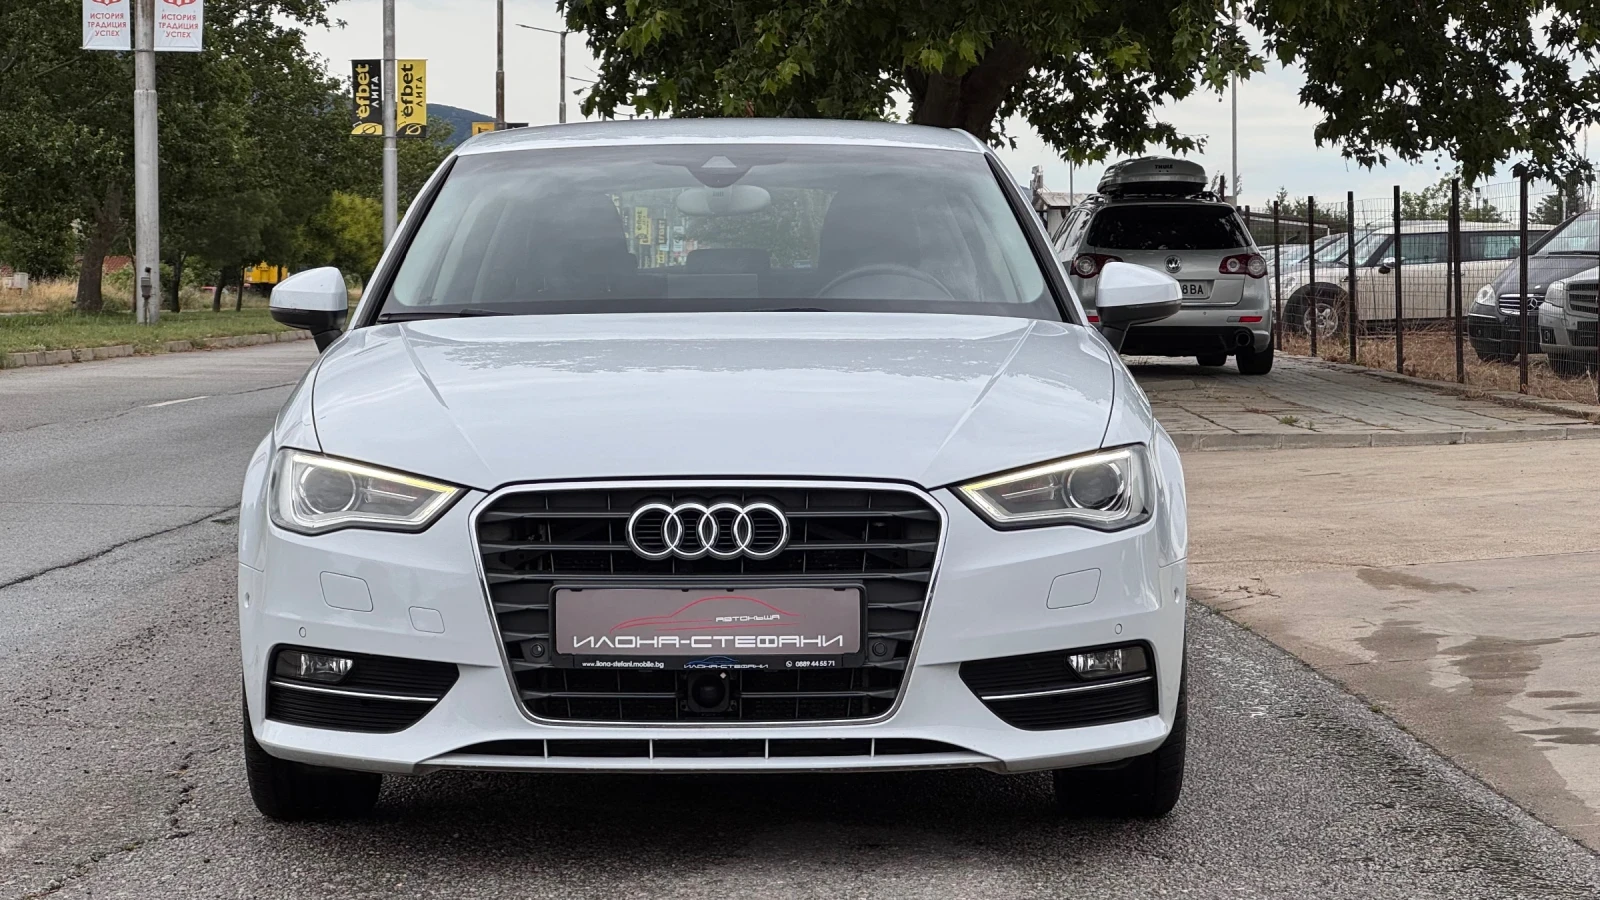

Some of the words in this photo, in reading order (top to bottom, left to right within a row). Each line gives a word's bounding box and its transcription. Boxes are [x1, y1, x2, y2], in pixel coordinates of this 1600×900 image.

[355, 63, 370, 119] efbet
[371, 76, 379, 107] ЛИГА
[400, 63, 413, 118] efbet
[415, 76, 423, 107] ЛИГА
[573, 635, 843, 649] ИЛОНА-СТЕФАНИ
[582, 660, 664, 669] www.ilona-stefani.mobile.bg
